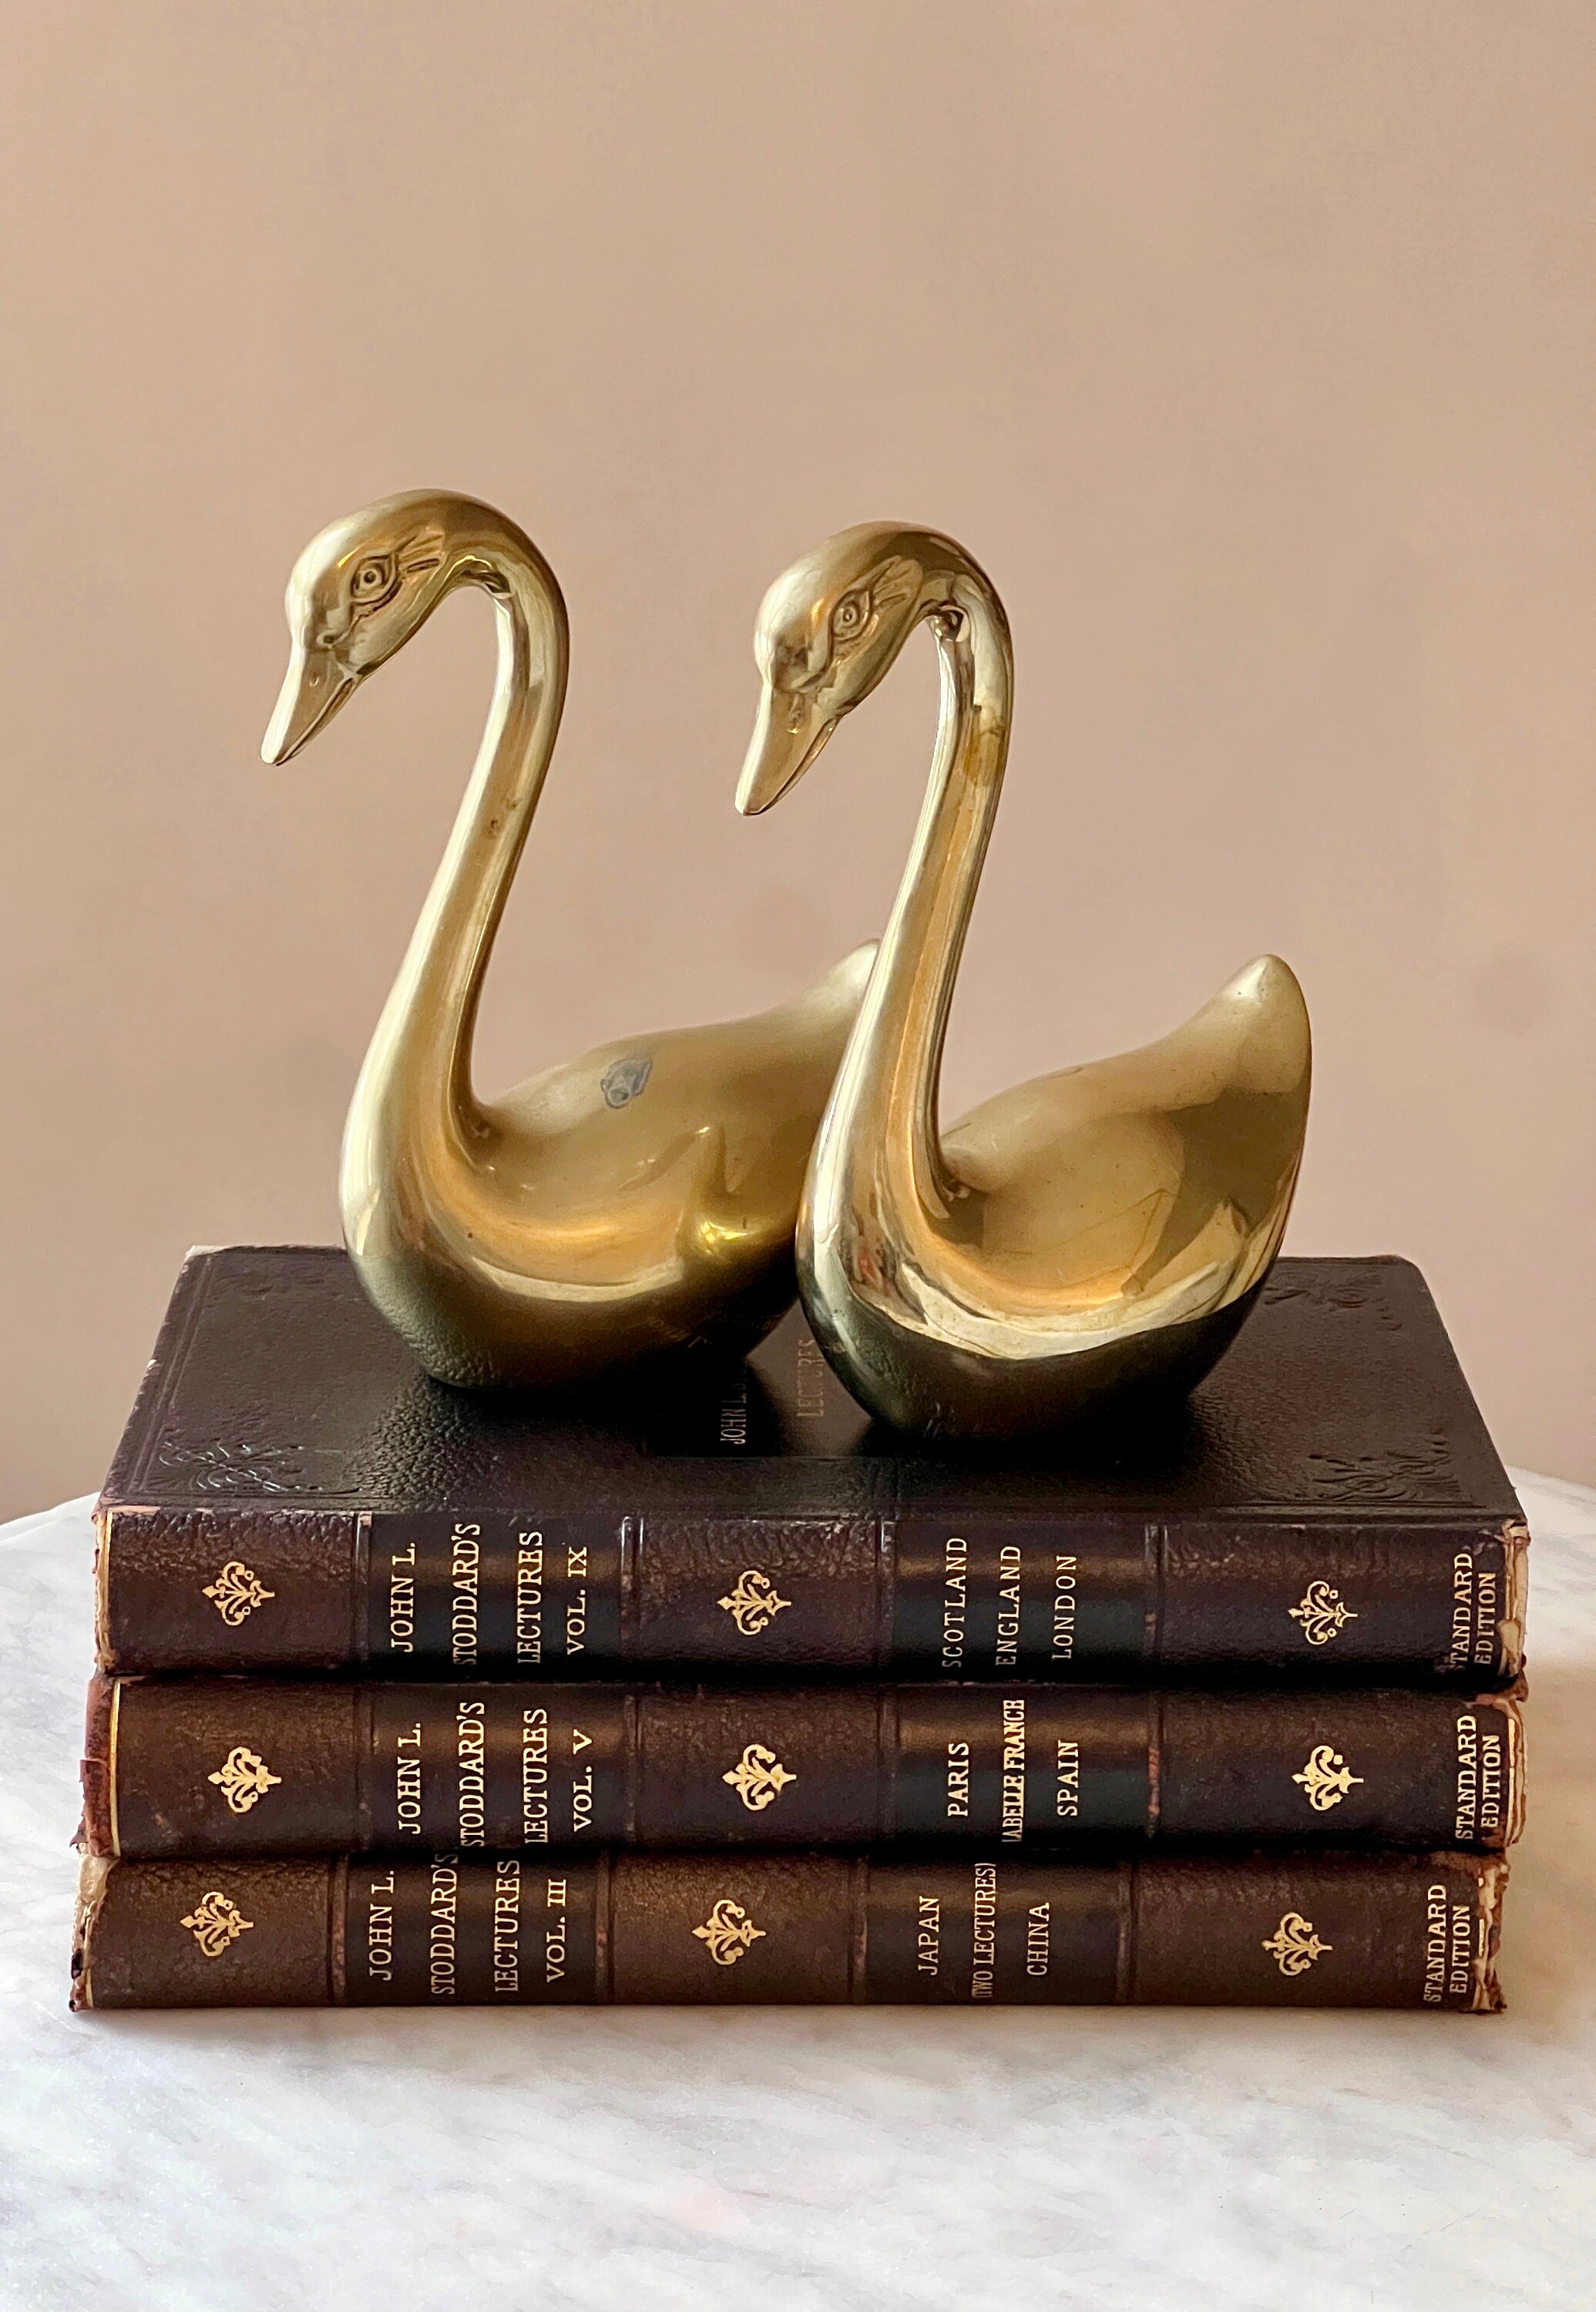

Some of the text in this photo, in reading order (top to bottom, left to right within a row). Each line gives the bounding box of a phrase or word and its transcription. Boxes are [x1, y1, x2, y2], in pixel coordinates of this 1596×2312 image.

[720, 1408, 747, 1444] JOHN
[390, 1542, 415, 1652] JOHN L.
[451, 1524, 480, 1665] STODDARD'S
[517, 1531, 543, 1663] LECTURES
[566, 1546, 587, 1655] VOL. IX
[942, 1537, 967, 1668] SCOTLAND
[996, 1546, 1021, 1665] ENGLAND
[1052, 1555, 1077, 1659] LONDON
[1473, 1573, 1496, 1665] EDITION
[397, 1722, 421, 1834] JOHN L.
[456, 1702, 485, 1847] STODDARD'S
[523, 1709, 548, 1844] LECTURES
[573, 1729, 593, 1832] VOL. V
[947, 1742, 969, 1816] PARIS
[1003, 1699, 1025, 1771] FRANCE
[1057, 1739, 1078, 1816] SPAIN
[1455, 1715, 1477, 1840] STANDARD
[1480, 1735, 1500, 1828] EDITION
[368, 1870, 395, 1981] JOHN L.
[430, 1853, 459, 1994] STODDARD'S
[494, 1860, 520, 1992] LECTURES
[546, 1879, 566, 1982] VOL. III
[918, 1895, 939, 1976] JAPAN
[973, 1863, 996, 1966] LECTURES)
[1026, 1902, 1050, 1976] CHINA
[1423, 1884, 1446, 2002] STANDARD
[1450, 1905, 1470, 1993] EDITION
